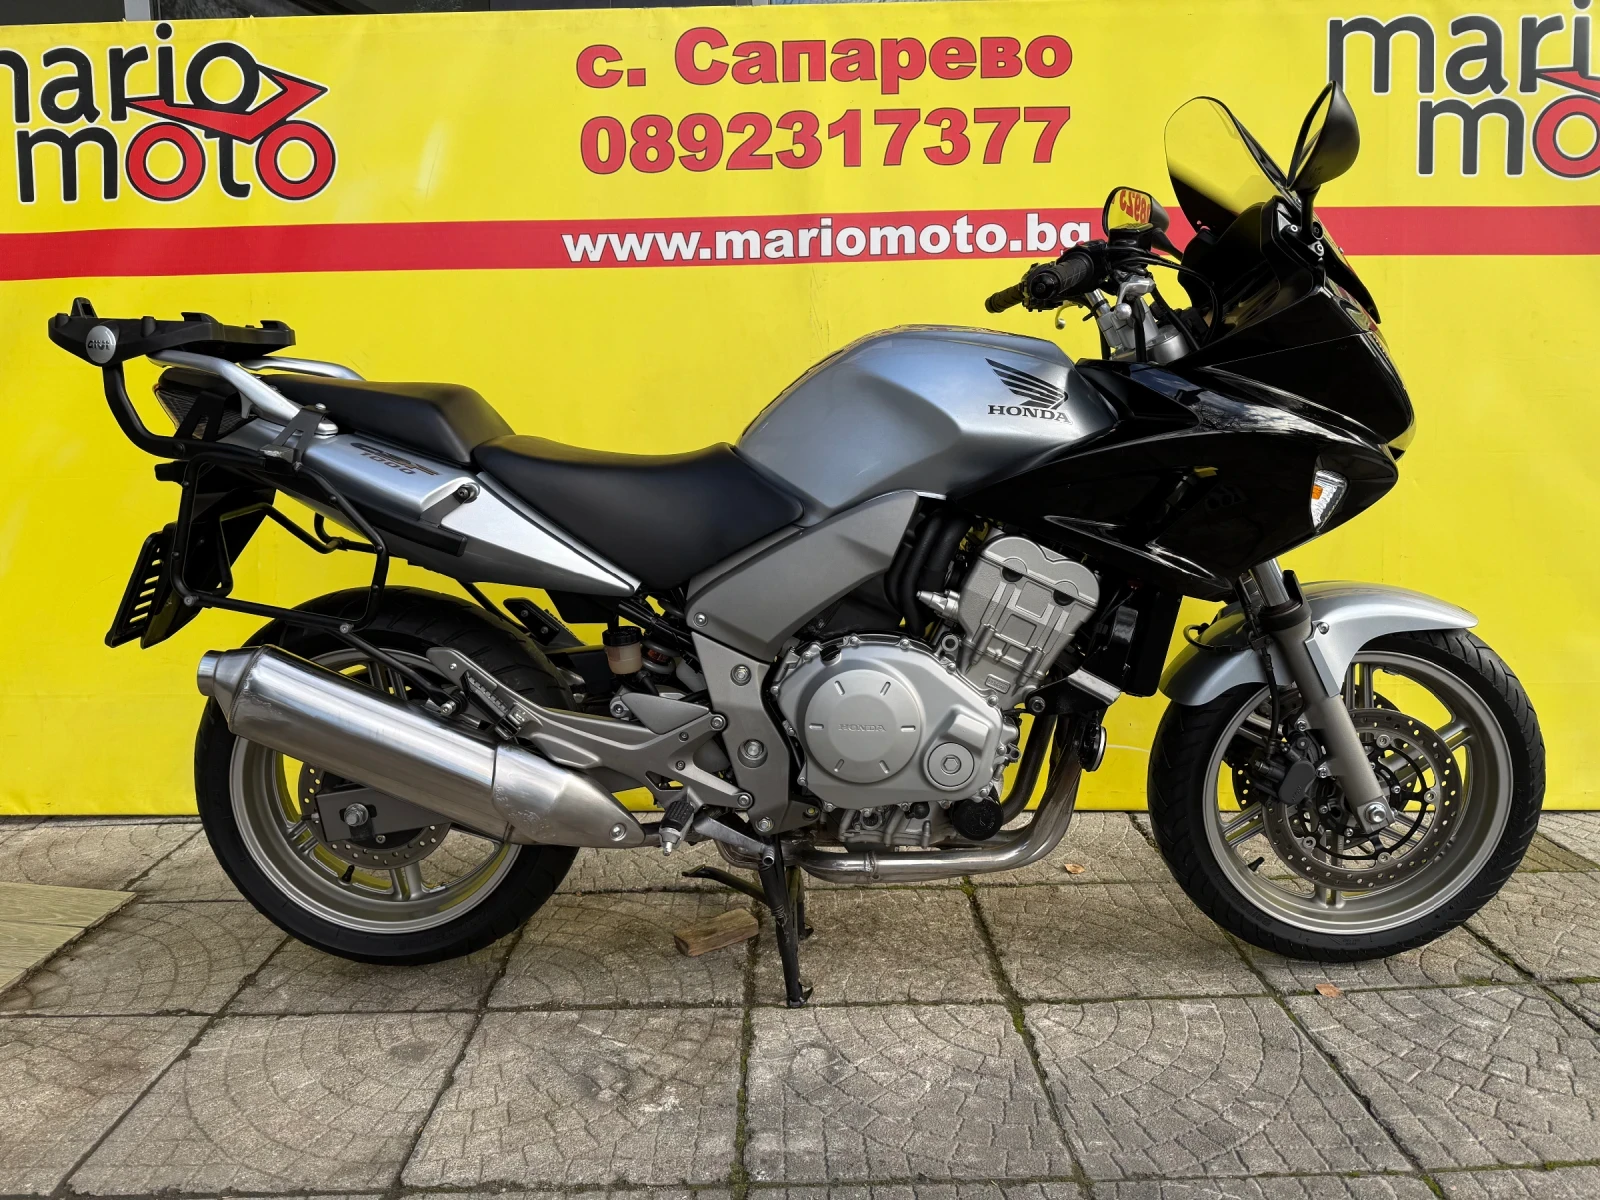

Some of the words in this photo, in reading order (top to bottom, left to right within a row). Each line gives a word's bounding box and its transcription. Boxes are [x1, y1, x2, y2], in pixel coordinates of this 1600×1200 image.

[0, 23, 260, 124] ario
[576, 44, 647, 89] с.
[674, 26, 1074, 95] Сапарево
[16, 119, 336, 202] moto
[580, 106, 1072, 175] 0892317377
[561, 213, 1090, 262] www.mariomoto.bg
[987, 404, 1072, 423] HONDA
[838, 723, 887, 732] HONDA
